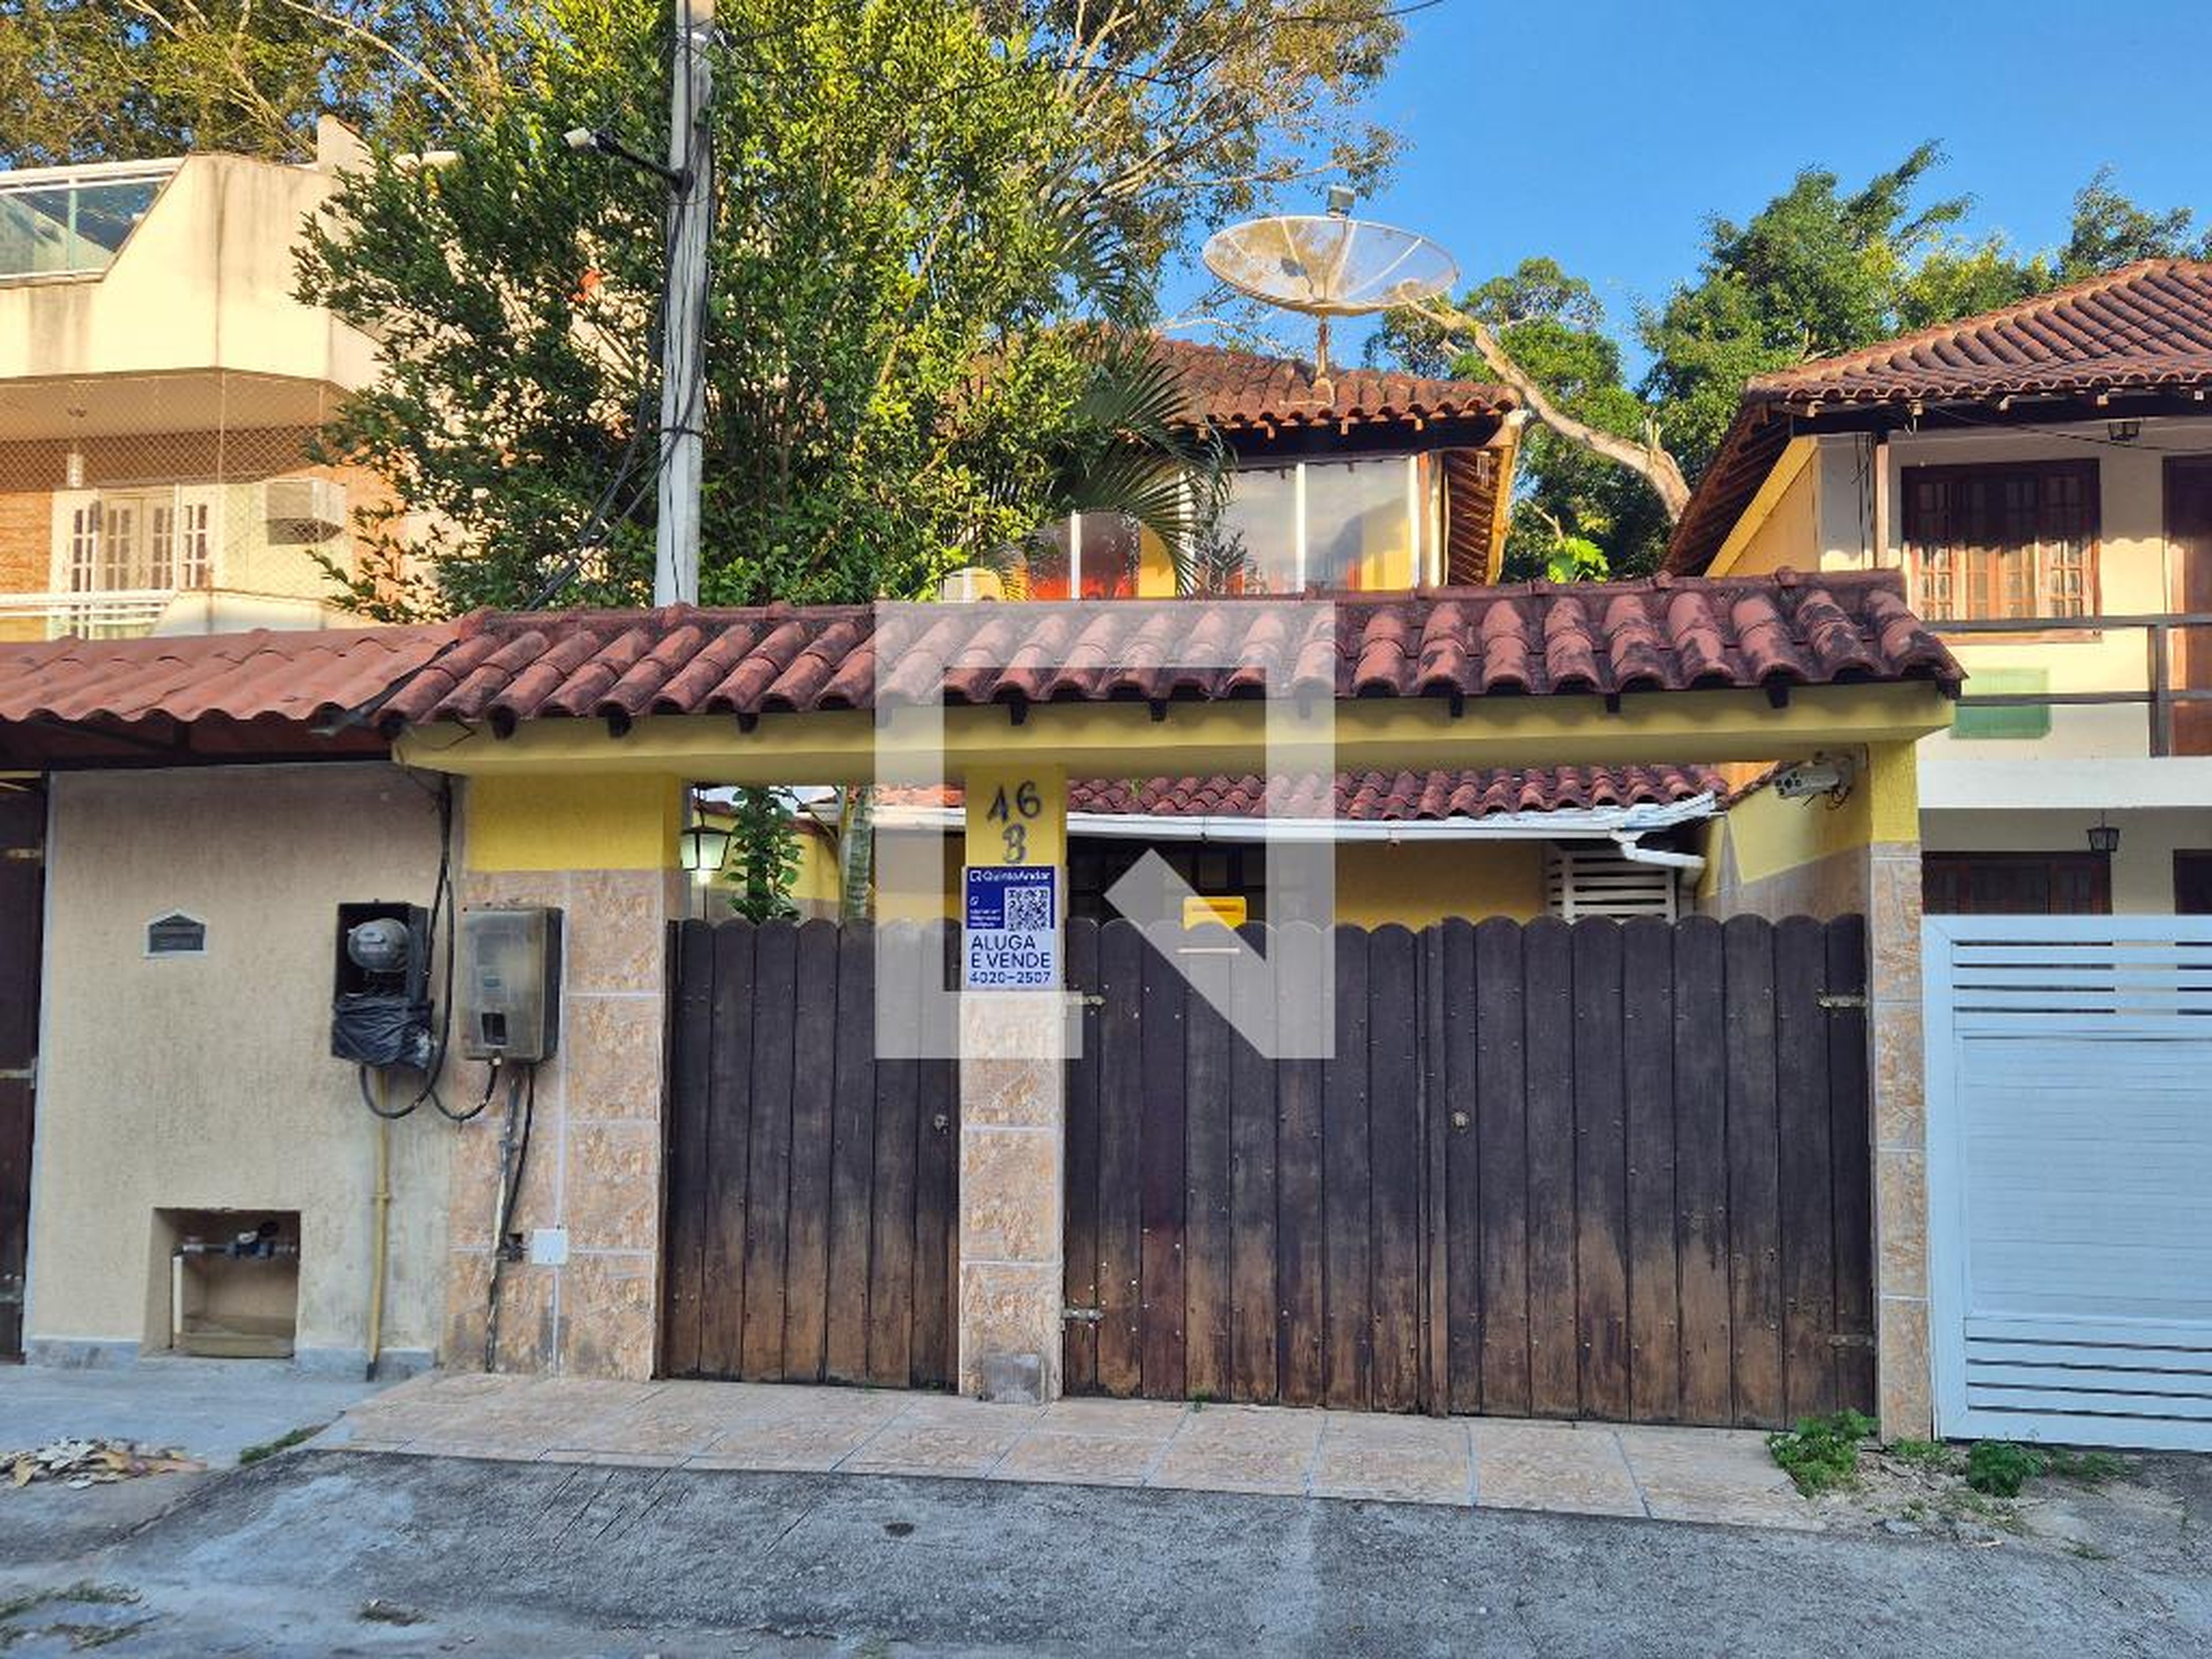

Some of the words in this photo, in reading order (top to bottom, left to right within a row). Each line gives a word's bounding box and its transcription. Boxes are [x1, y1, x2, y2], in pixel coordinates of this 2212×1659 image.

[986, 779, 1041, 822] 16
[971, 934, 1036, 950] ALUGA
[971, 952, 981, 968] E
[986, 952, 1051, 968] VENDE
[969, 971, 1051, 984] 4020-2507
